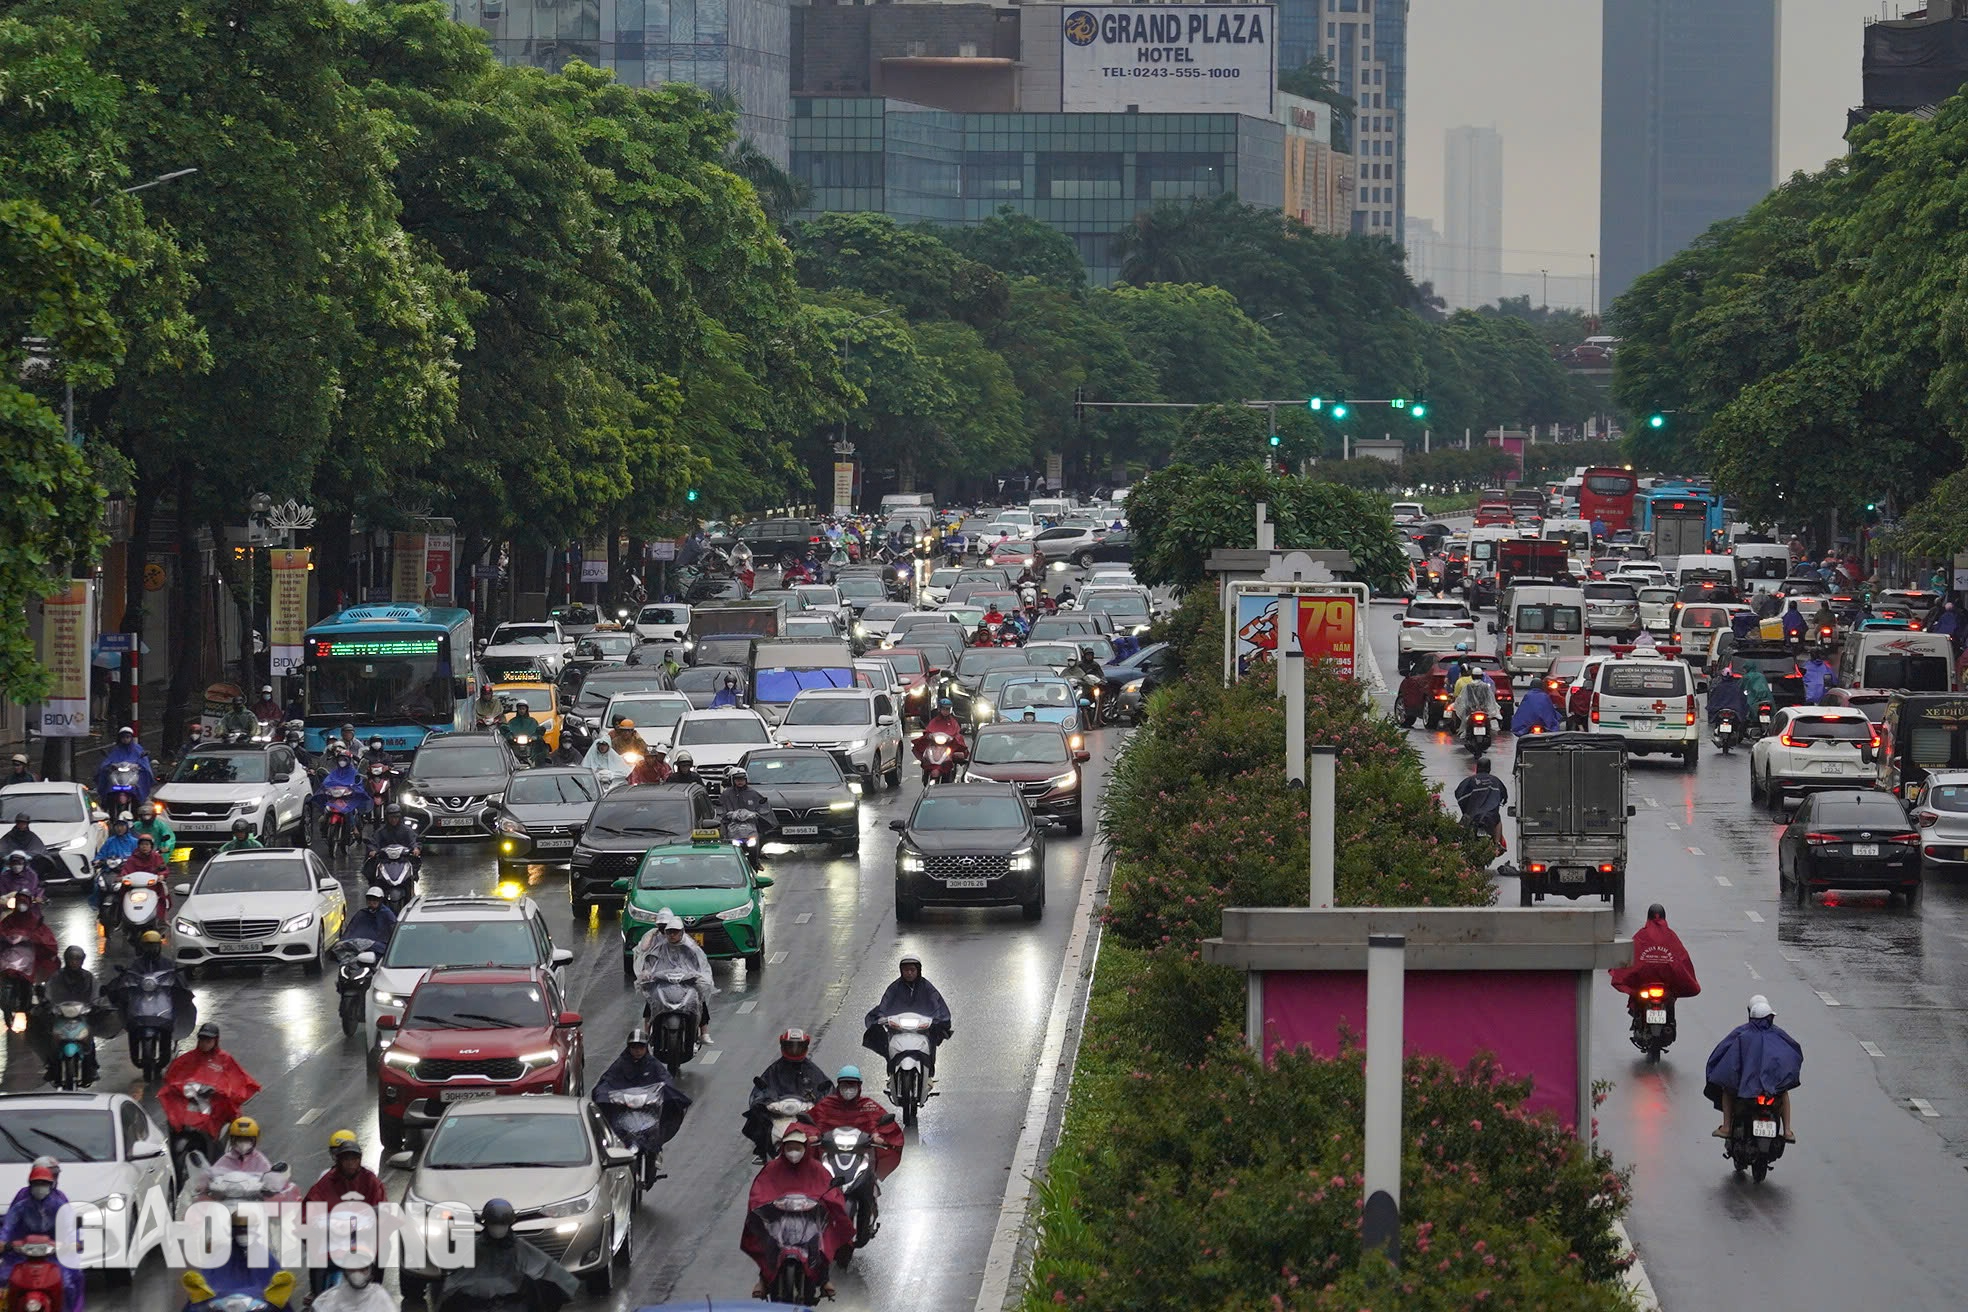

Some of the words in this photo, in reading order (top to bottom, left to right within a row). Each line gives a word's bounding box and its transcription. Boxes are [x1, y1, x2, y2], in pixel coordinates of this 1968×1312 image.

[1101, 13, 1181, 44] GRAND
[1188, 13, 1264, 44] PLAZA
[1137, 47, 1194, 63] HOTEL
[1300, 601, 1353, 641] 79
[1333, 641, 1351, 651] NĂM
[273, 658, 298, 667] BIDV
[1925, 708, 1941, 716] XE
[44, 713, 74, 726] BIDV
